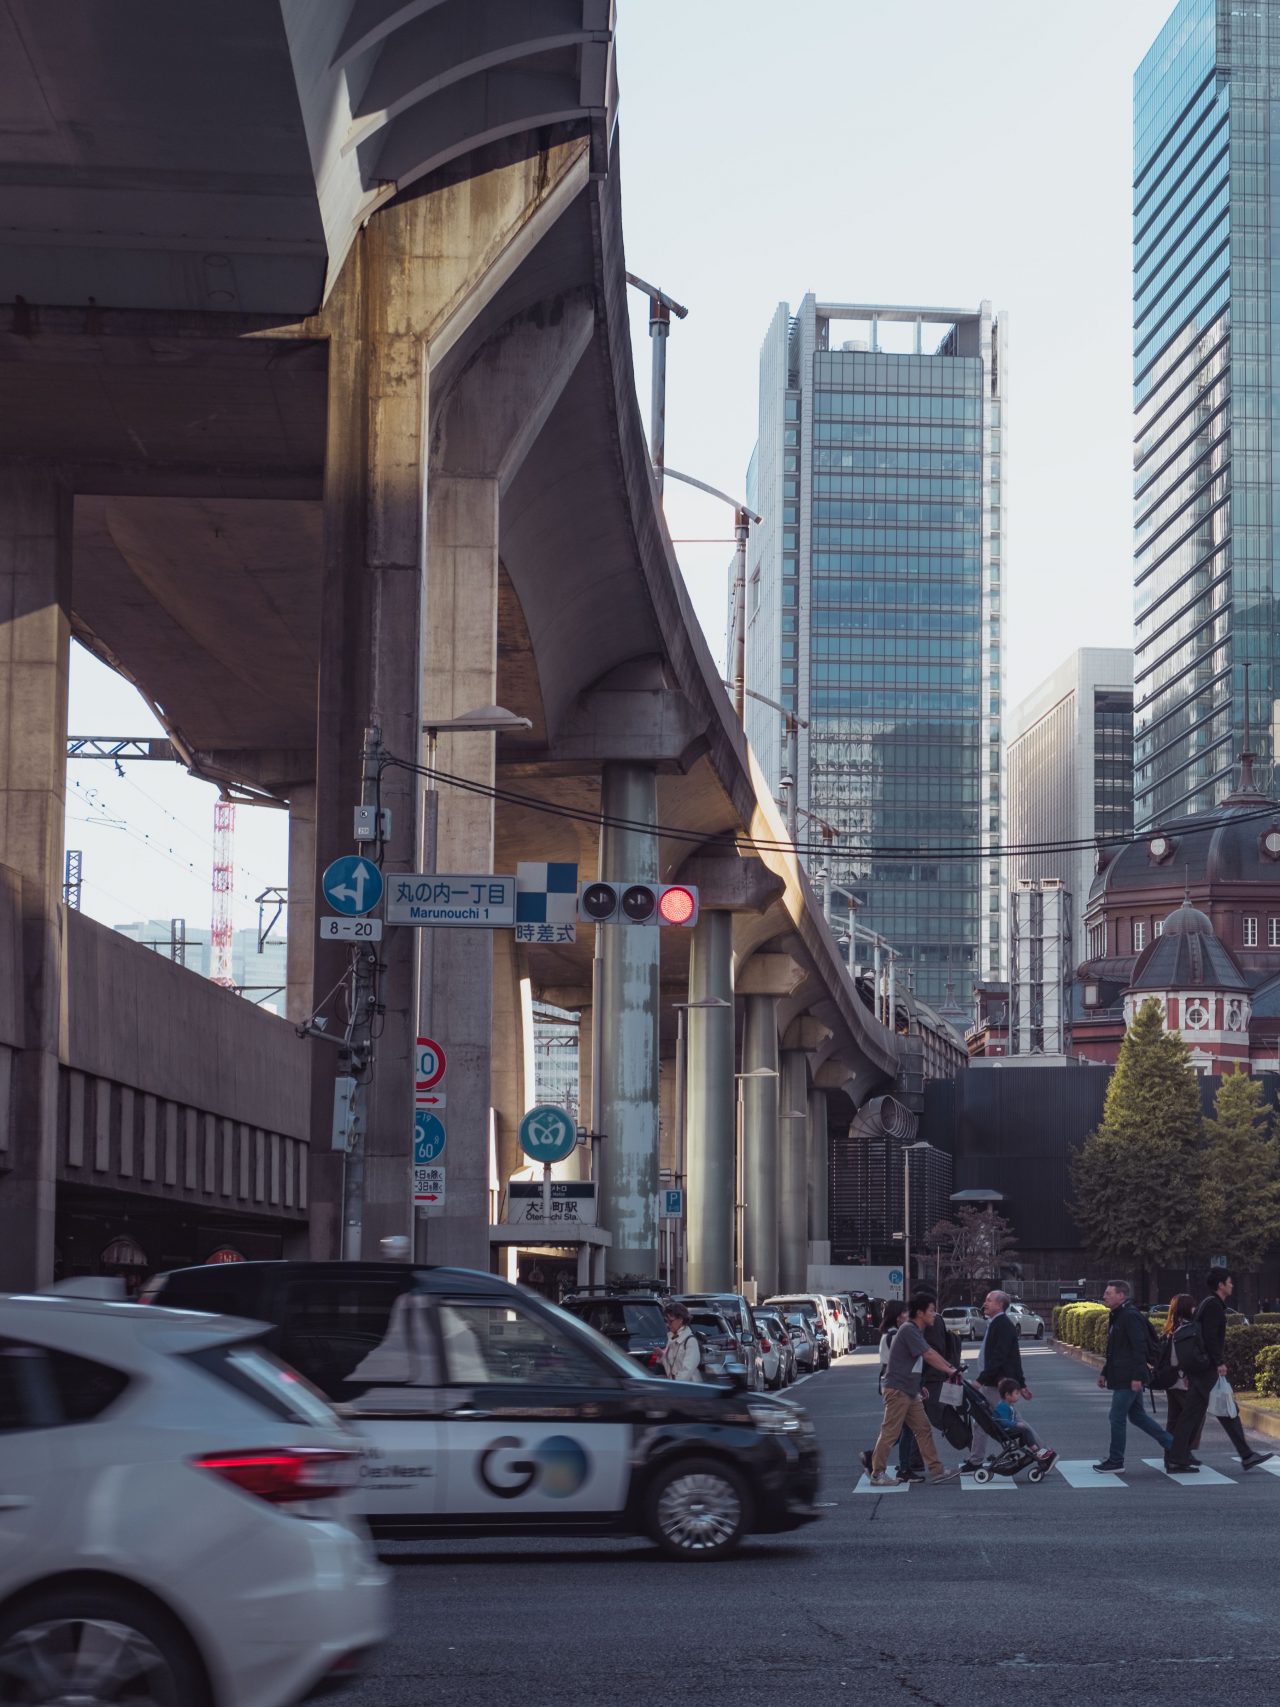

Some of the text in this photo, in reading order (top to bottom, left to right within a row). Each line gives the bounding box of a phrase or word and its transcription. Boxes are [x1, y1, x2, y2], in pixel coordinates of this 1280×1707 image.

[396, 881, 505, 905] 丸の内一丁目
[410, 906, 489, 919] Marunouchi 1
[516, 924, 575, 942] 時差式
[416, 1052, 435, 1075] 0
